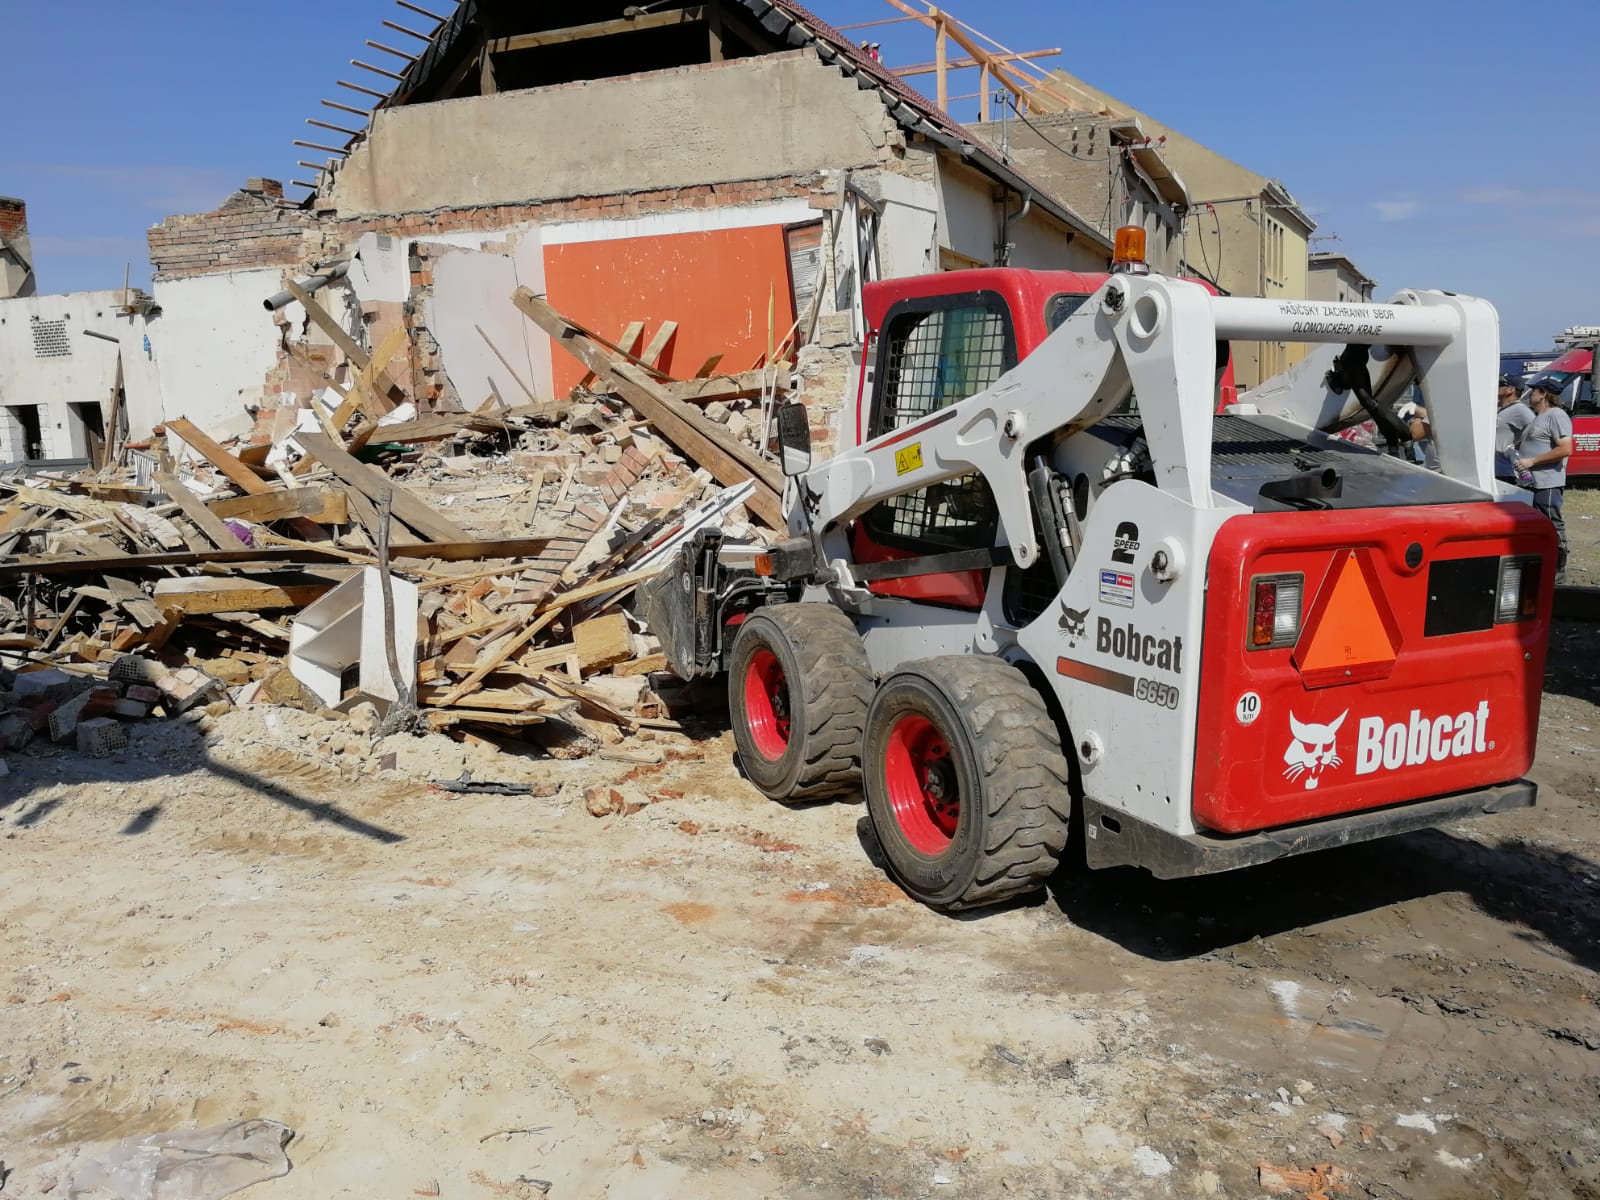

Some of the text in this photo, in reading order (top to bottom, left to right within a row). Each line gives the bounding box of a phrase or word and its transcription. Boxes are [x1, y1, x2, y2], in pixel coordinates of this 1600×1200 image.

[1373, 308, 1397, 320] SBOR
[1356, 324, 1383, 336] KRAJE
[1113, 538, 1140, 551] SPEED
[1097, 616, 1183, 674] Bobcat
[1136, 677, 1180, 710] S650
[1239, 695, 1257, 713] 10
[1355, 700, 1490, 776] Bobcat
